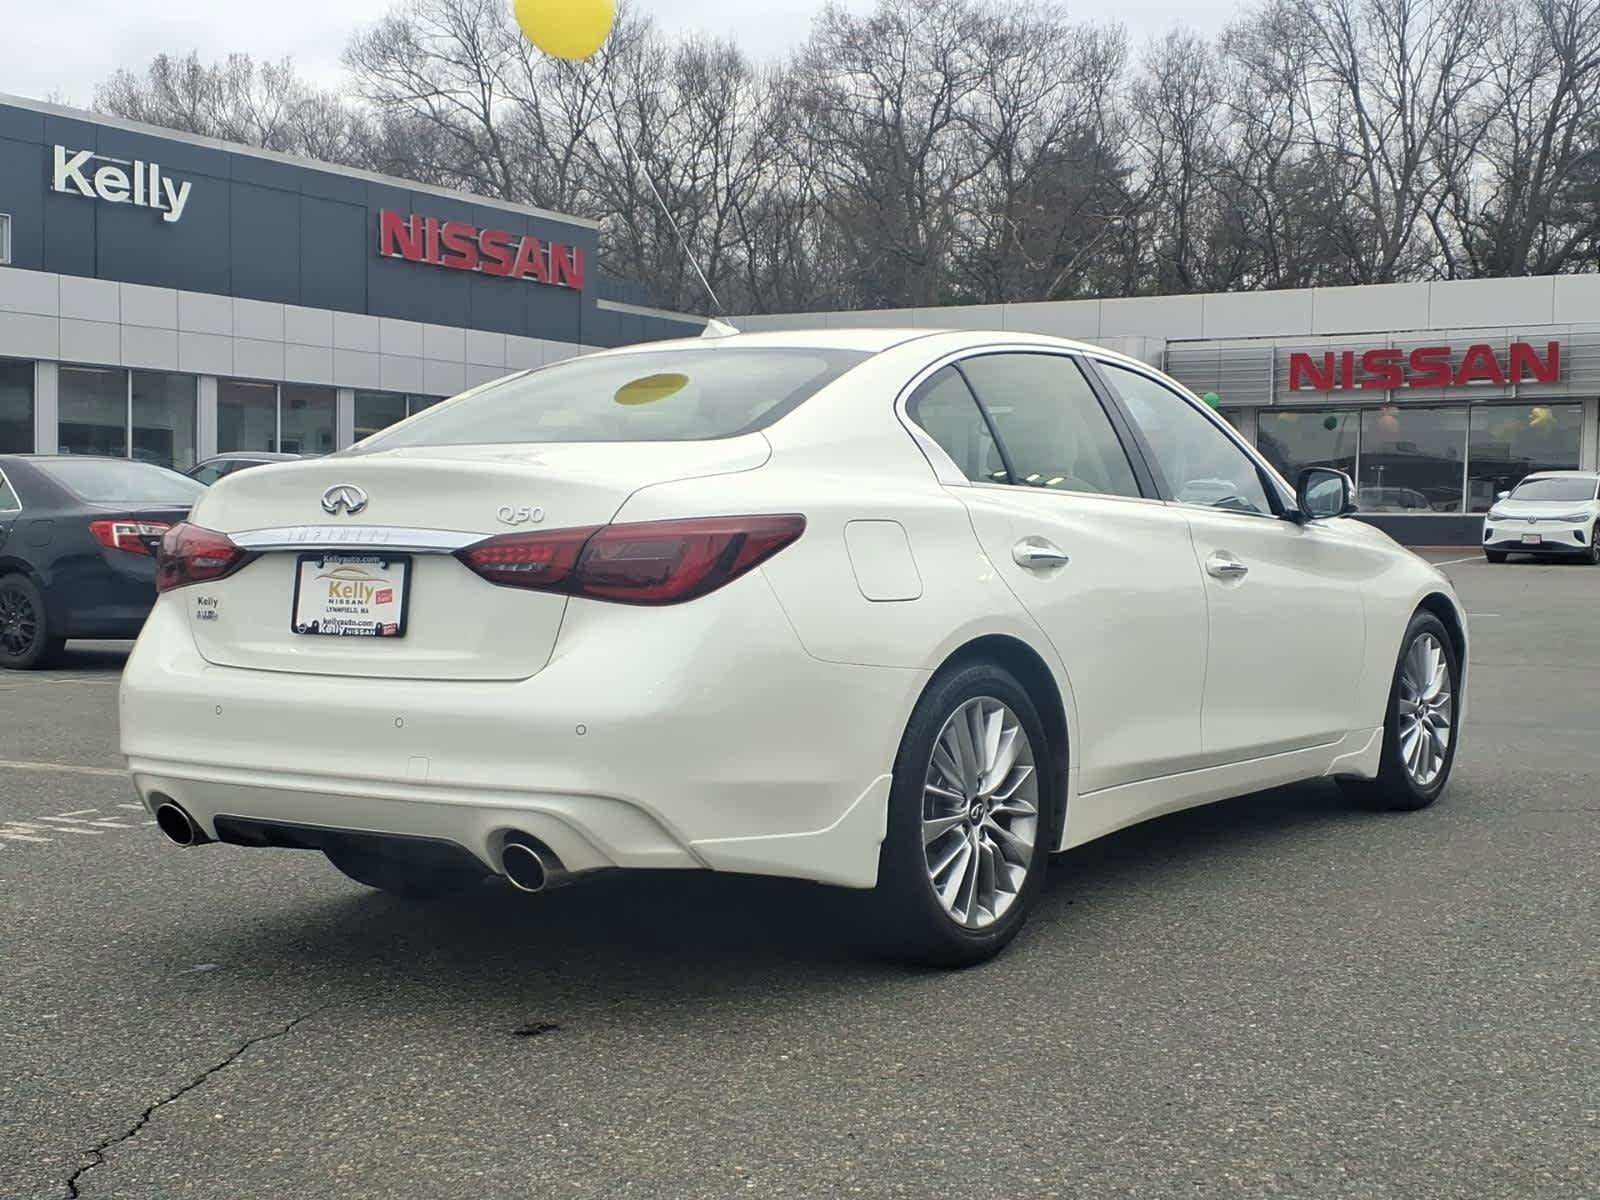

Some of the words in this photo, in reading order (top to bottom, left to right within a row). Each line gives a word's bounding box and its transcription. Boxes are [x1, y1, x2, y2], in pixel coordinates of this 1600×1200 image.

[52, 144, 192, 222] Kelly
[379, 208, 585, 291] NISSAN
[1288, 341, 1561, 392] NISSAN
[496, 504, 545, 527] Q50
[287, 525, 392, 543] INFINITI
[197, 596, 218, 609] Kelly
[328, 580, 375, 604] Kelly
[318, 623, 344, 635] Kelly
